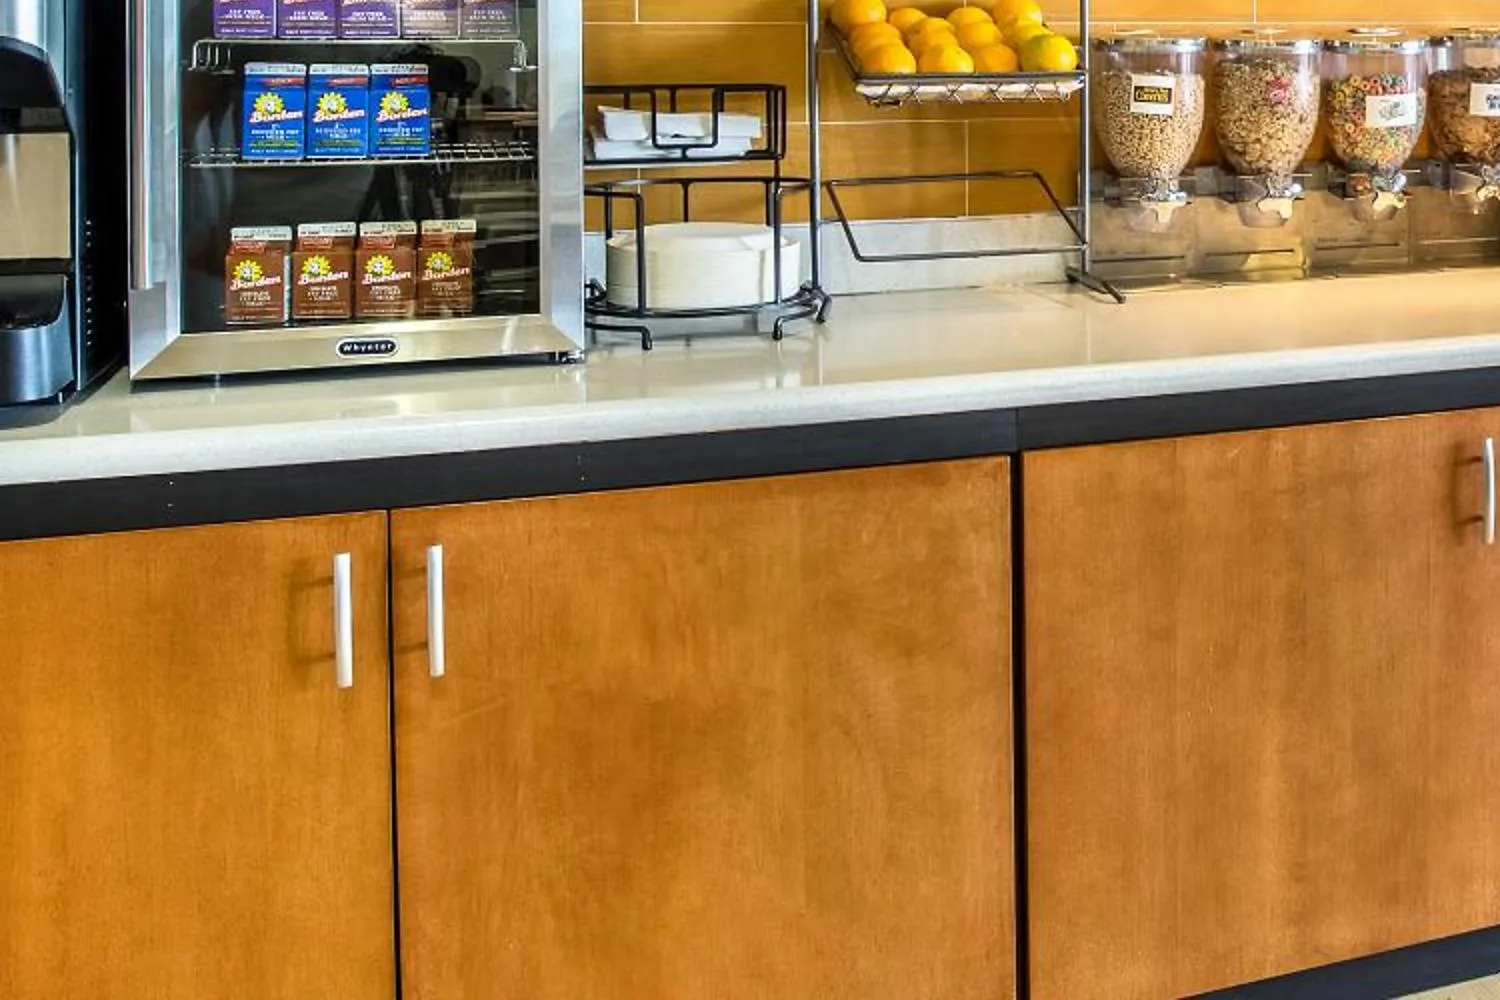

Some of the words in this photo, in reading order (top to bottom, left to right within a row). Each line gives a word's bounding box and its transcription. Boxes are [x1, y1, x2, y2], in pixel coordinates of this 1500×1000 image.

[249, 109, 304, 123] Borden
[312, 109, 365, 122] Borden
[375, 108, 428, 123] Borden
[297, 270, 350, 285] Borden
[361, 271, 411, 285] Borden
[420, 267, 470, 281] Borden
[229, 275, 281, 291] Borden
[343, 343, 393, 352] Whynter
